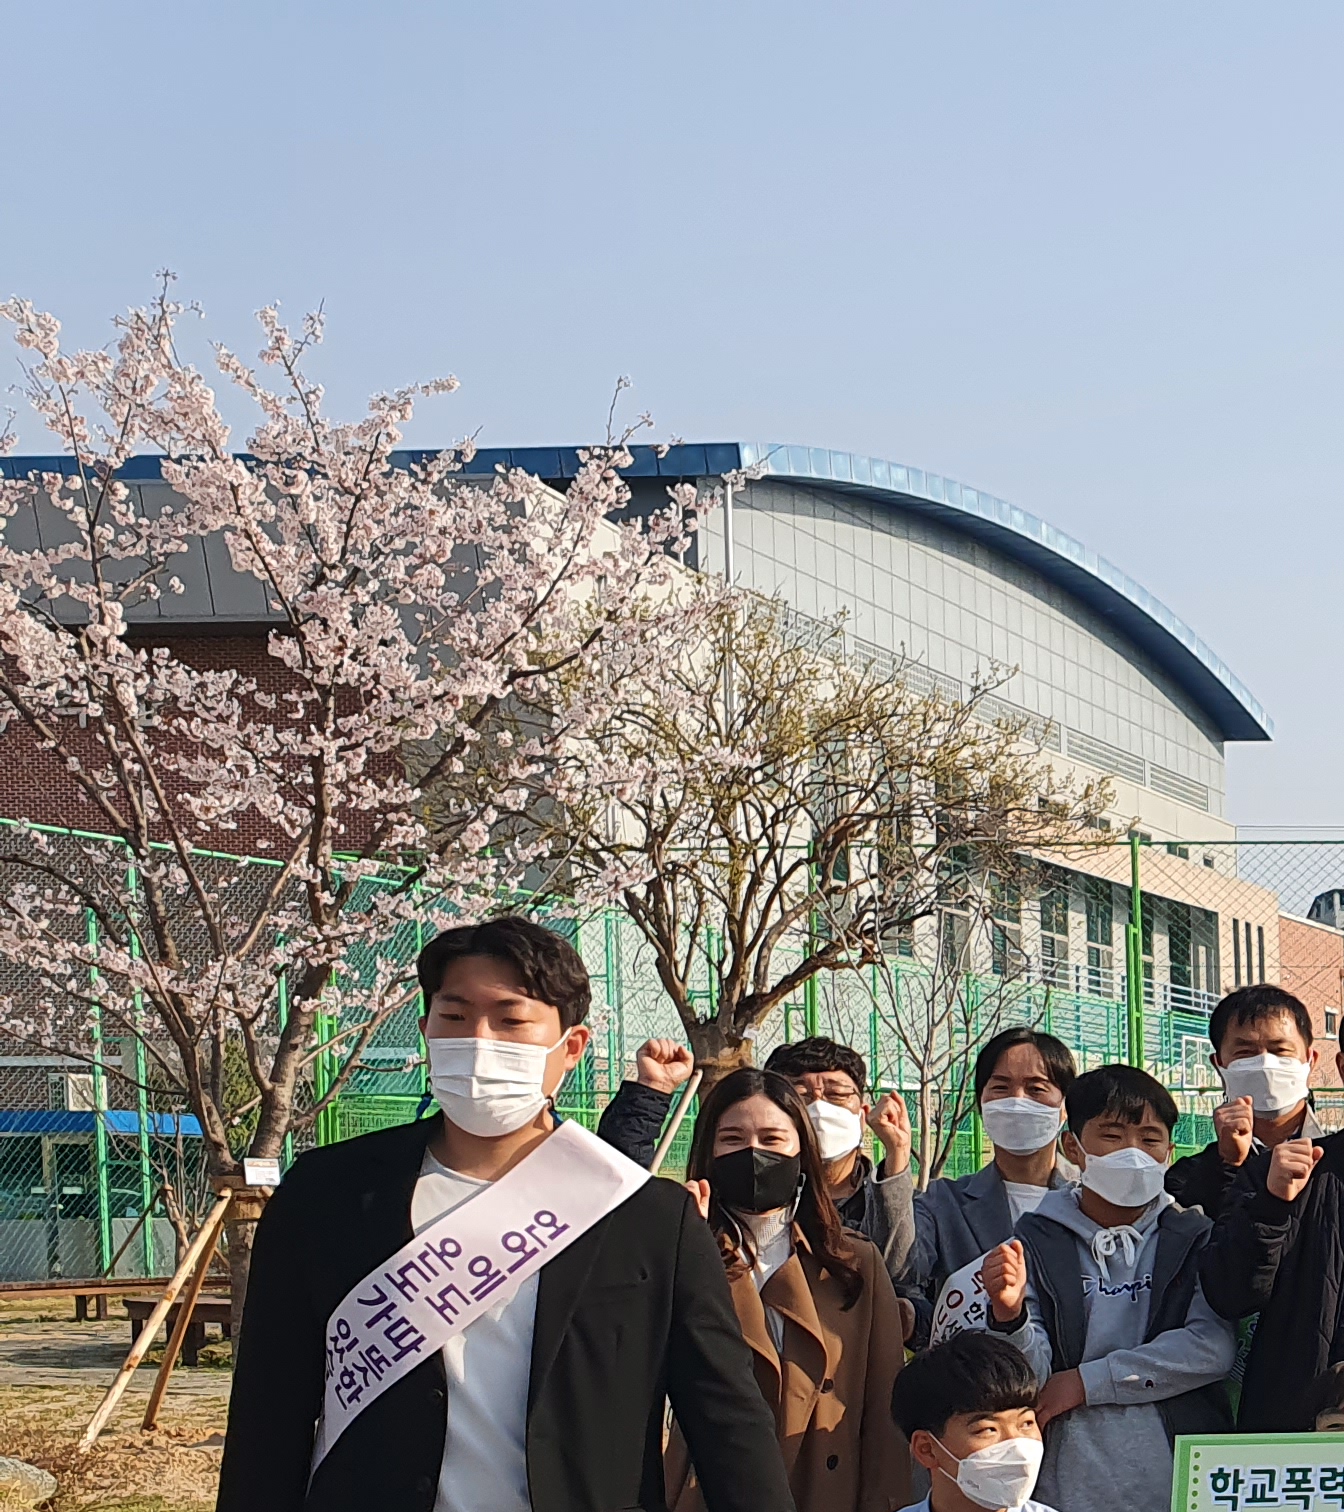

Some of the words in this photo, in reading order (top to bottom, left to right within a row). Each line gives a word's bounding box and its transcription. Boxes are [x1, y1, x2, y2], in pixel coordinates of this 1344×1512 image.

[357, 1237, 462, 1330] 온도가
[425, 1209, 570, 1325] 언어에도
[335, 1320, 427, 1411] 따뜻한
